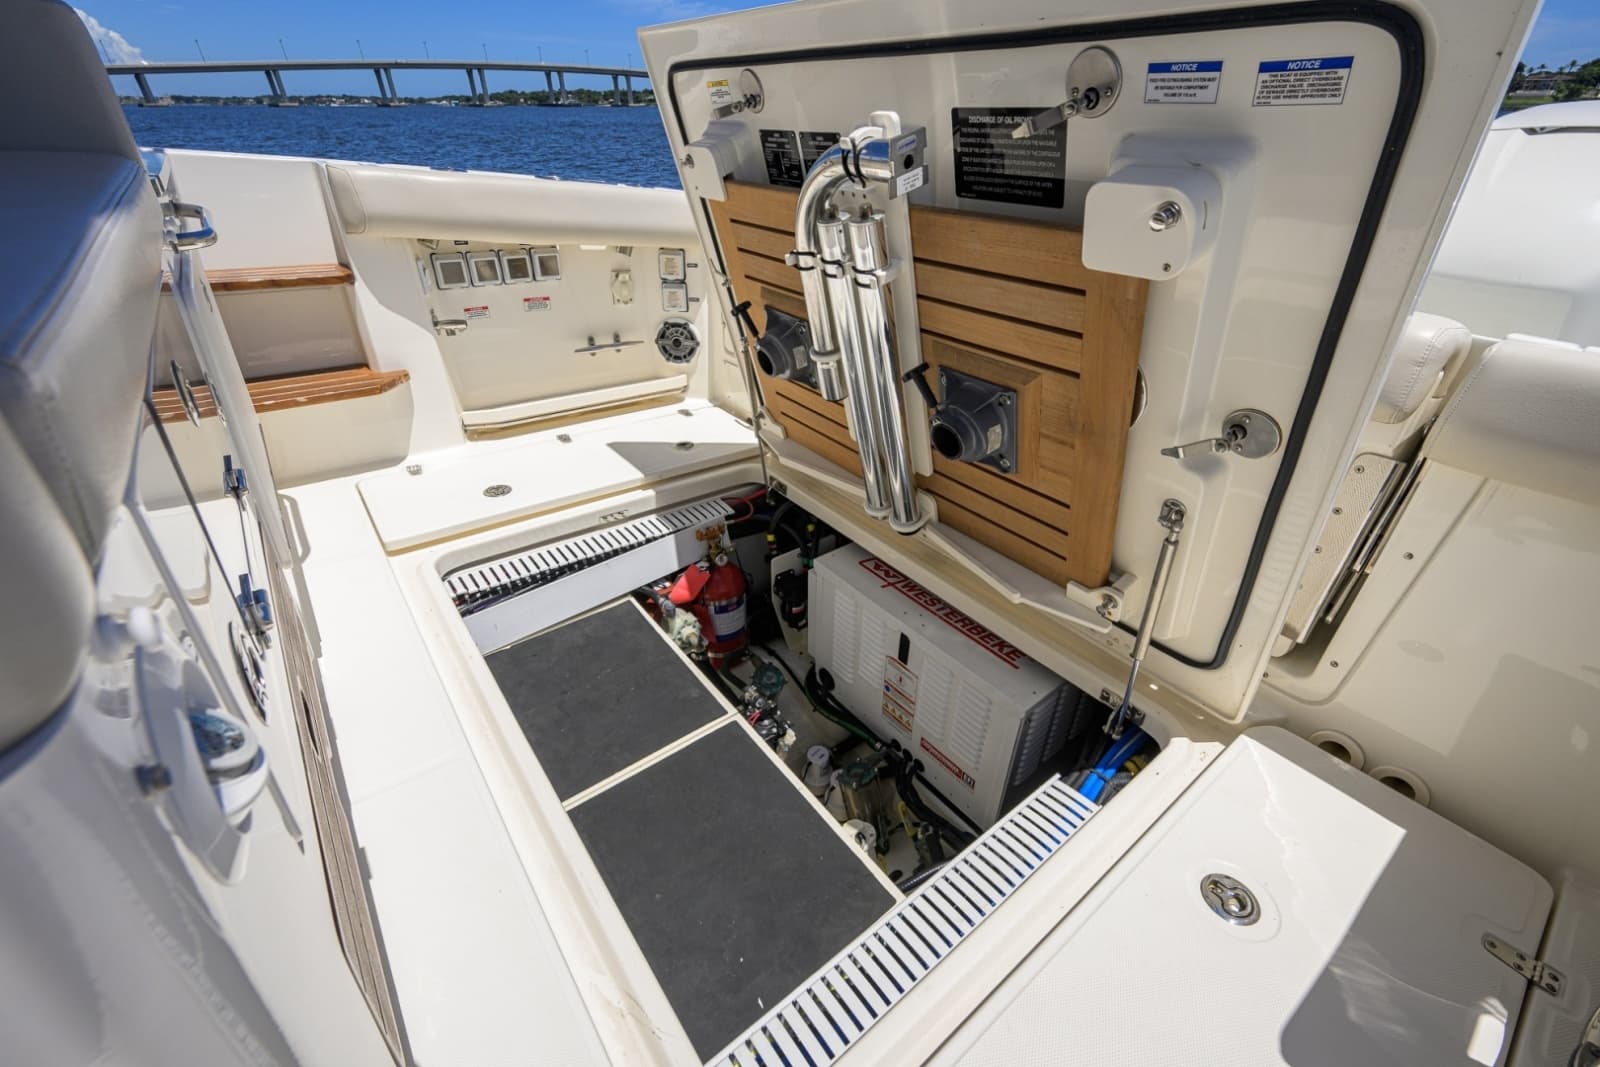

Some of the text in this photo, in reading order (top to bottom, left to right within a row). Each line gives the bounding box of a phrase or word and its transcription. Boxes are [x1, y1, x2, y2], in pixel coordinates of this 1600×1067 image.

[1170, 63, 1198, 71] NOTICE
[1287, 60, 1321, 70] NOTICE
[968, 115, 996, 124] DISCHARGE
[996, 116, 1003, 124] OF
[1004, 116, 1013, 124] OIL
[901, 580, 1022, 661] WESTERBEKE
